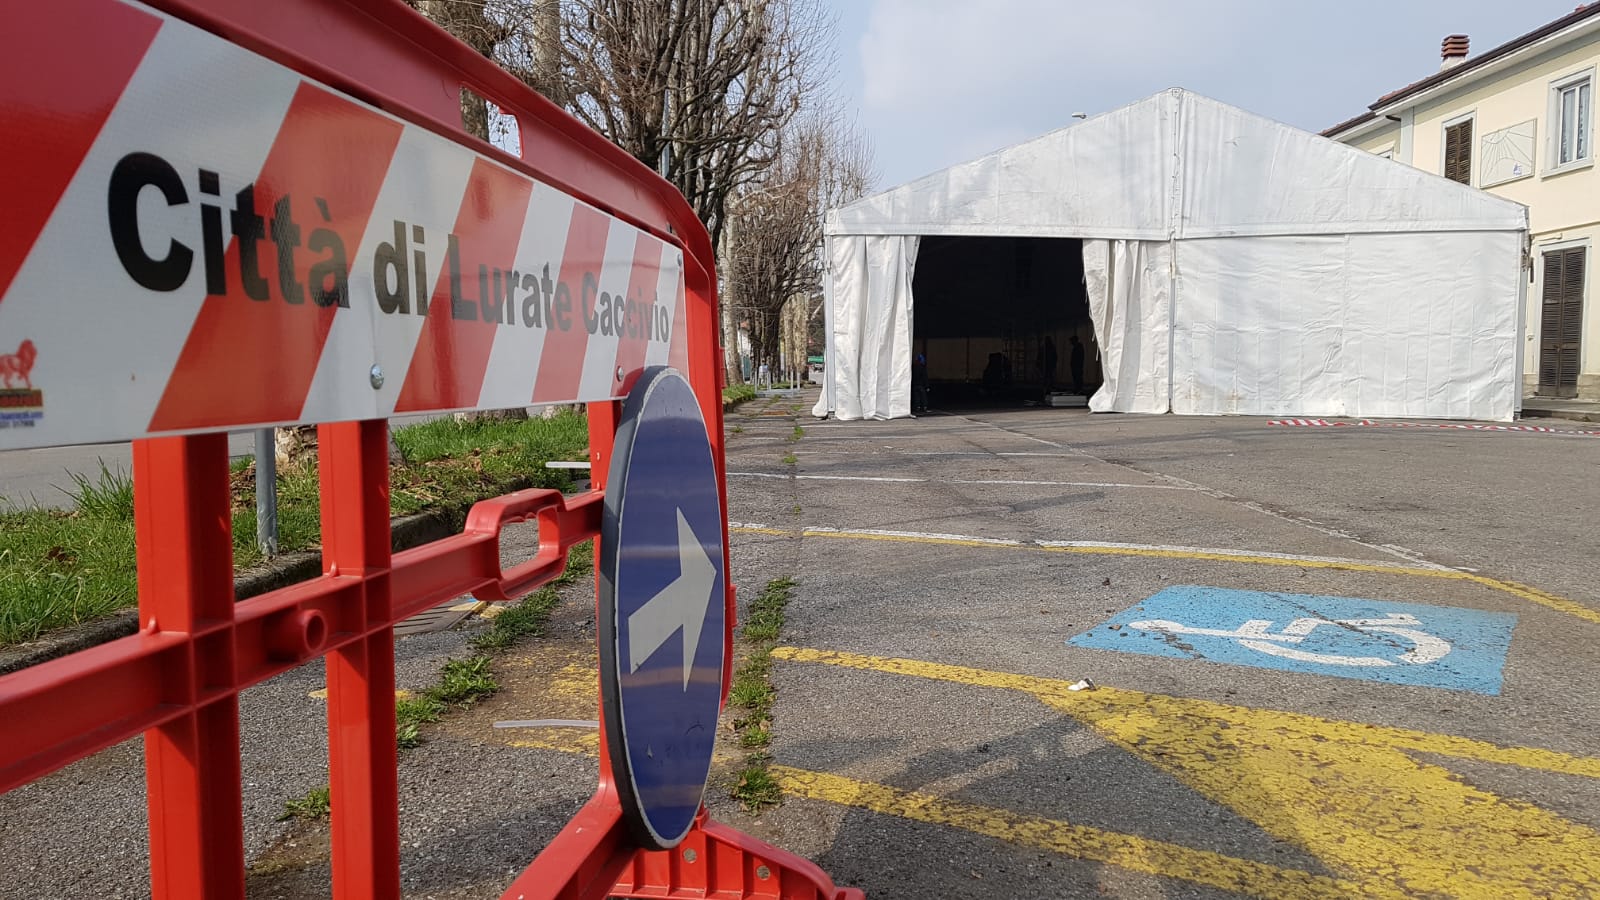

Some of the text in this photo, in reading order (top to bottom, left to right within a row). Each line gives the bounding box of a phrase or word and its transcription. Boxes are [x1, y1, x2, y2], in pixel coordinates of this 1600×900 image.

[108, 151, 670, 343] Città di Lurate Caccivio
